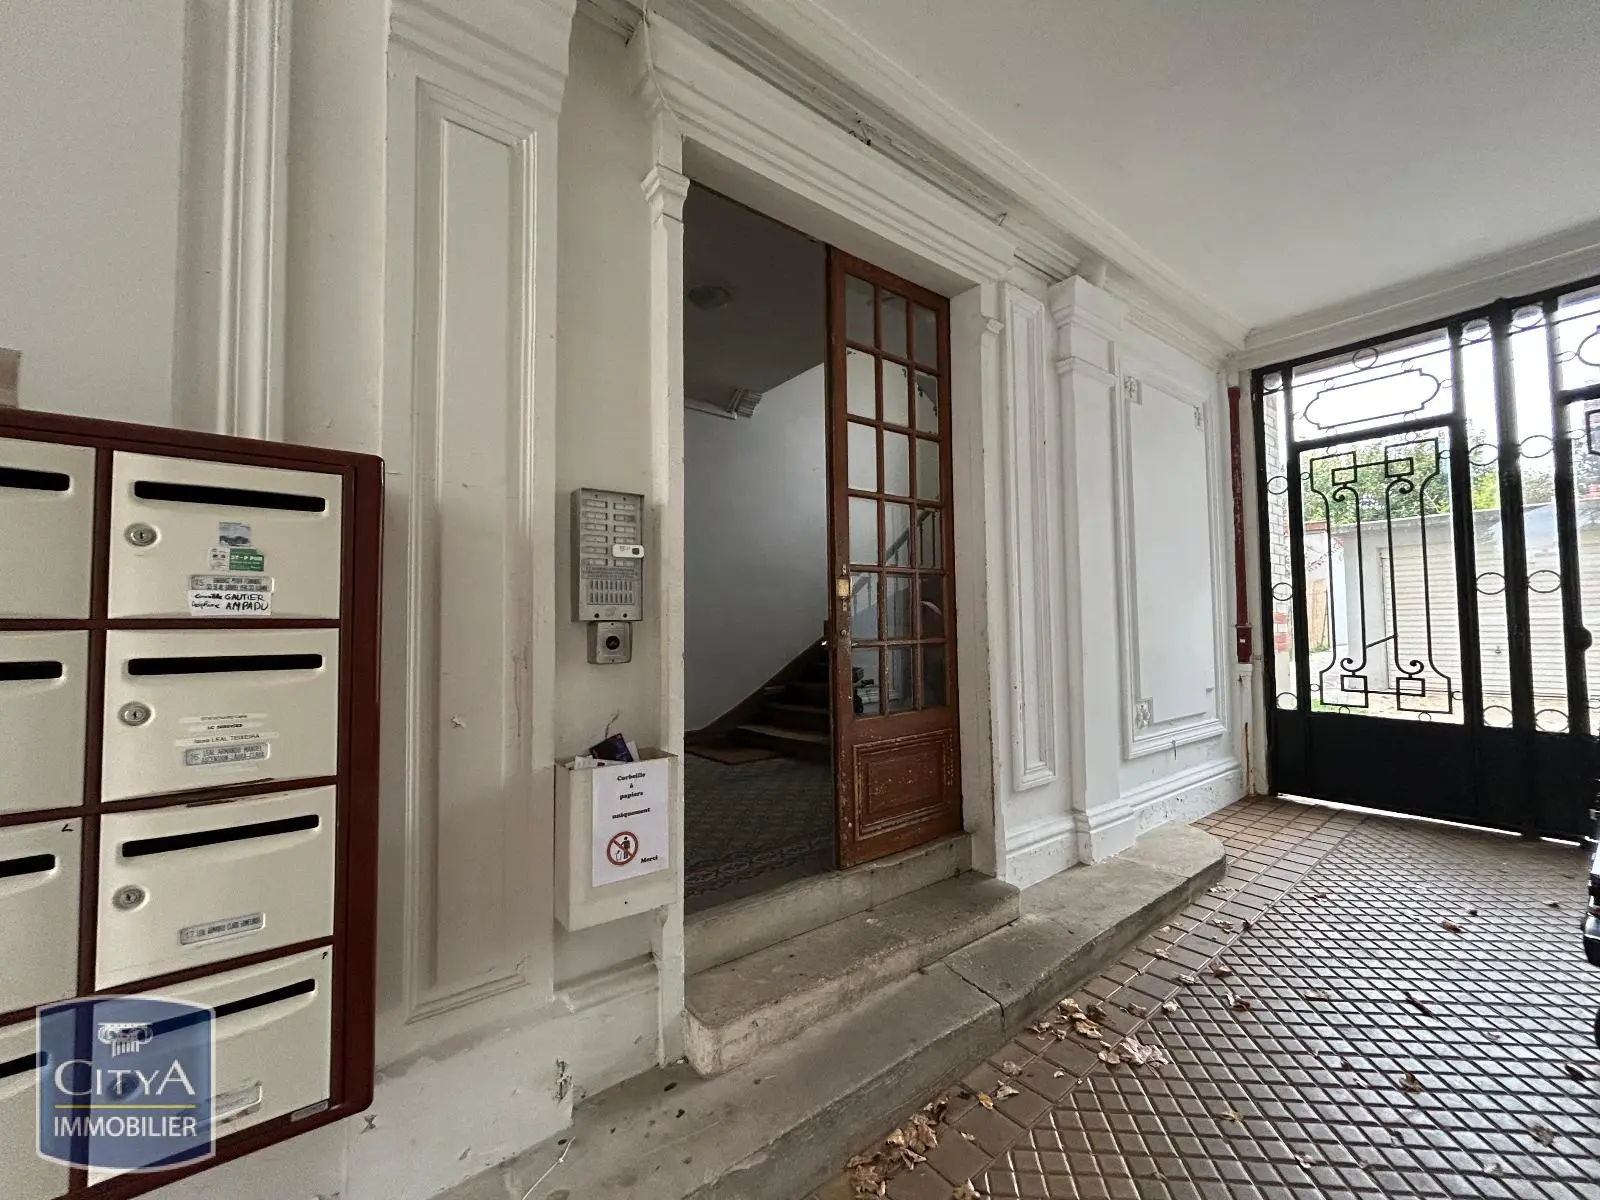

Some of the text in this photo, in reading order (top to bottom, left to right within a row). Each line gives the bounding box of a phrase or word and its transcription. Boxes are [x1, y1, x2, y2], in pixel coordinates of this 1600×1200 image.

[224, 593, 265, 602] GAUTIER
[225, 601, 269, 612] AMPADU
[617, 772, 645, 781] Corbeille
[619, 791, 644, 800] papiers
[611, 807, 651, 819] uniquement
[640, 855, 658, 863] Merci
